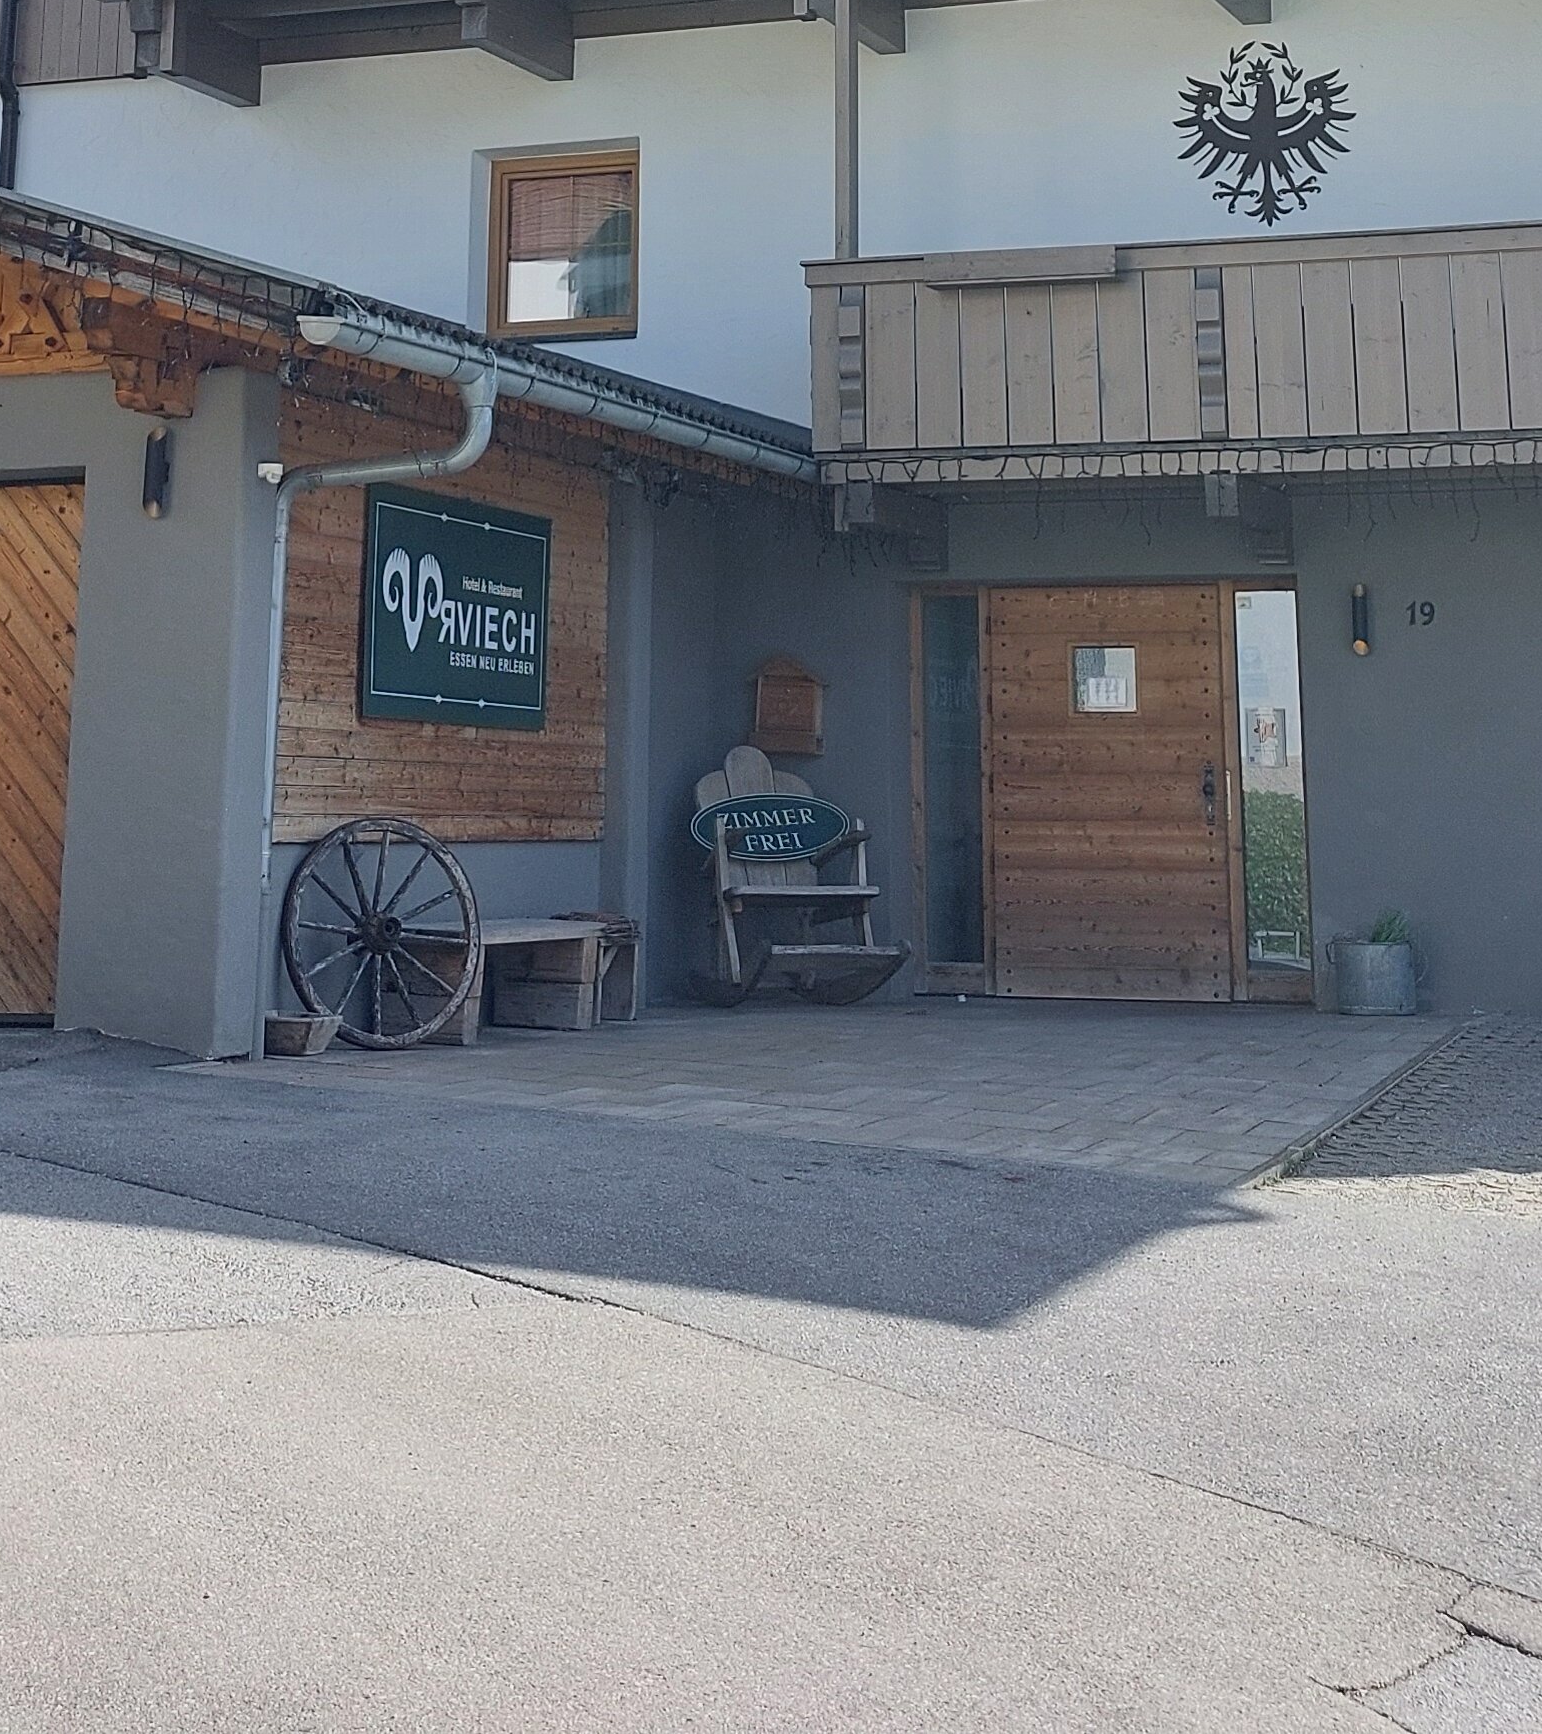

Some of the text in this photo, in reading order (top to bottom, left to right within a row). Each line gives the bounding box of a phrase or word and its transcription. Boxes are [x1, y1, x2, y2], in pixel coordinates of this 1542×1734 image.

[462, 575, 481, 593] Hotel
[1405, 600, 1436, 627] 19
[449, 650, 535, 676] ESSEN NEU ERLEBEN
[716, 808, 817, 829] ZIMMER
[744, 832, 804, 852] FREI
